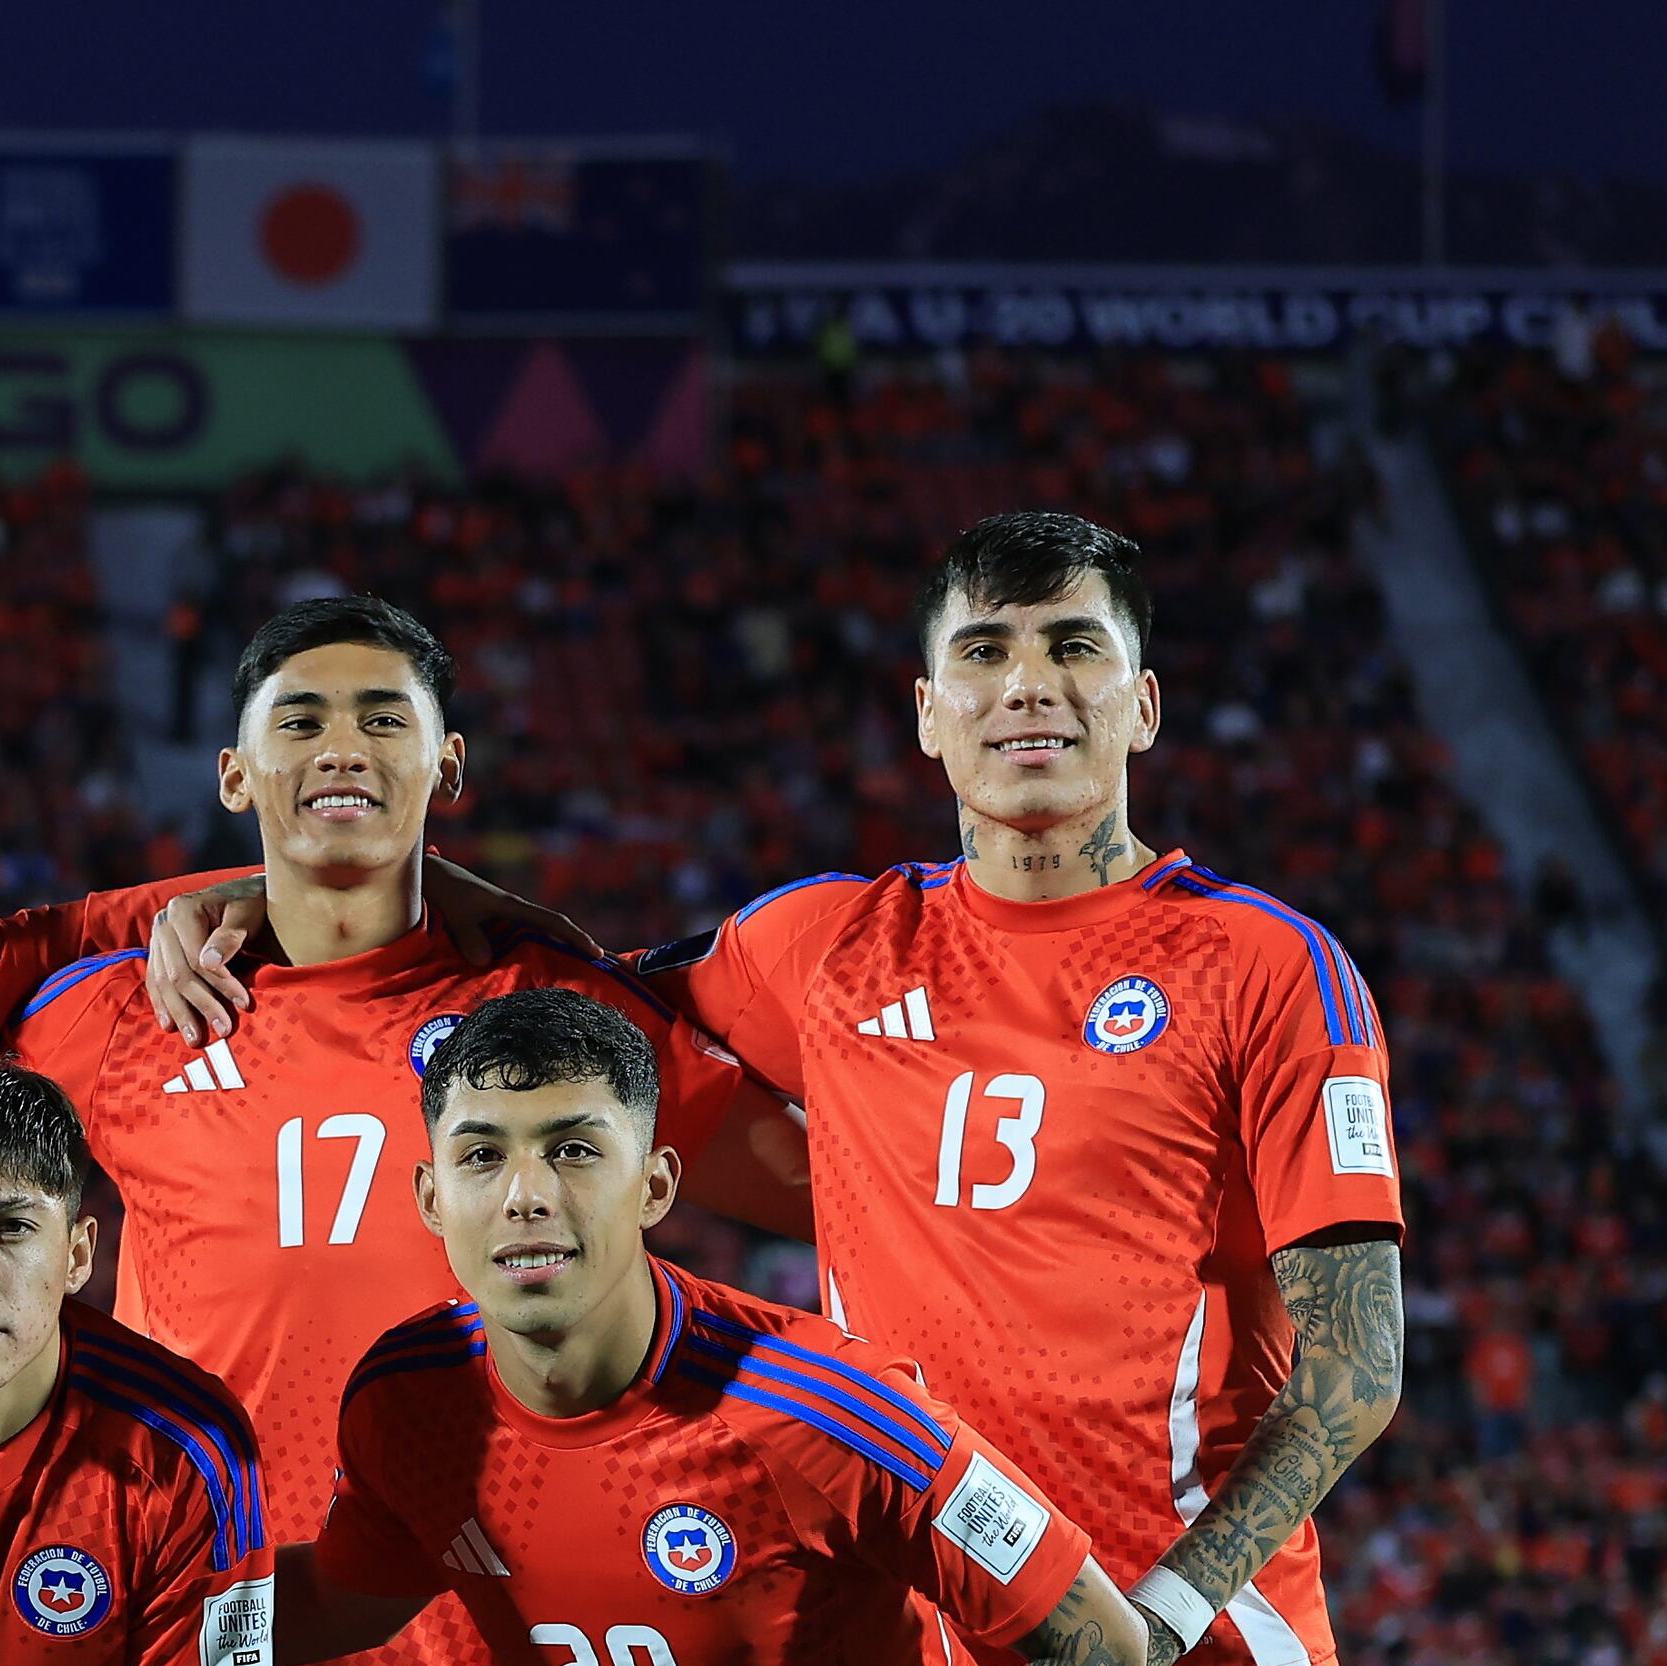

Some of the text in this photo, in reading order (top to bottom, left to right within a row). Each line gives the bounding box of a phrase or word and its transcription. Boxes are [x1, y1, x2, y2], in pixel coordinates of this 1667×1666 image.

[412, 1017, 452, 1057] FEDERACION
[933, 1070, 1047, 1211] 13
[275, 1112, 387, 1249] 17
[966, 1485, 1005, 1535] UNITES
[647, 1507, 681, 1552] FEDERACION
[687, 1507, 700, 1518] DE
[18, 1548, 64, 1587] FEDERACION
[70, 1549, 85, 1562] DE
[674, 1574, 721, 1592] DE CHILE
[218, 1597, 266, 1614] FOOTBALL
[218, 1609, 267, 1632] UNITES
[37, 1619, 85, 1634] DE CHILE
[216, 1633, 236, 1650] the
[235, 1652, 258, 1665] FIFA
